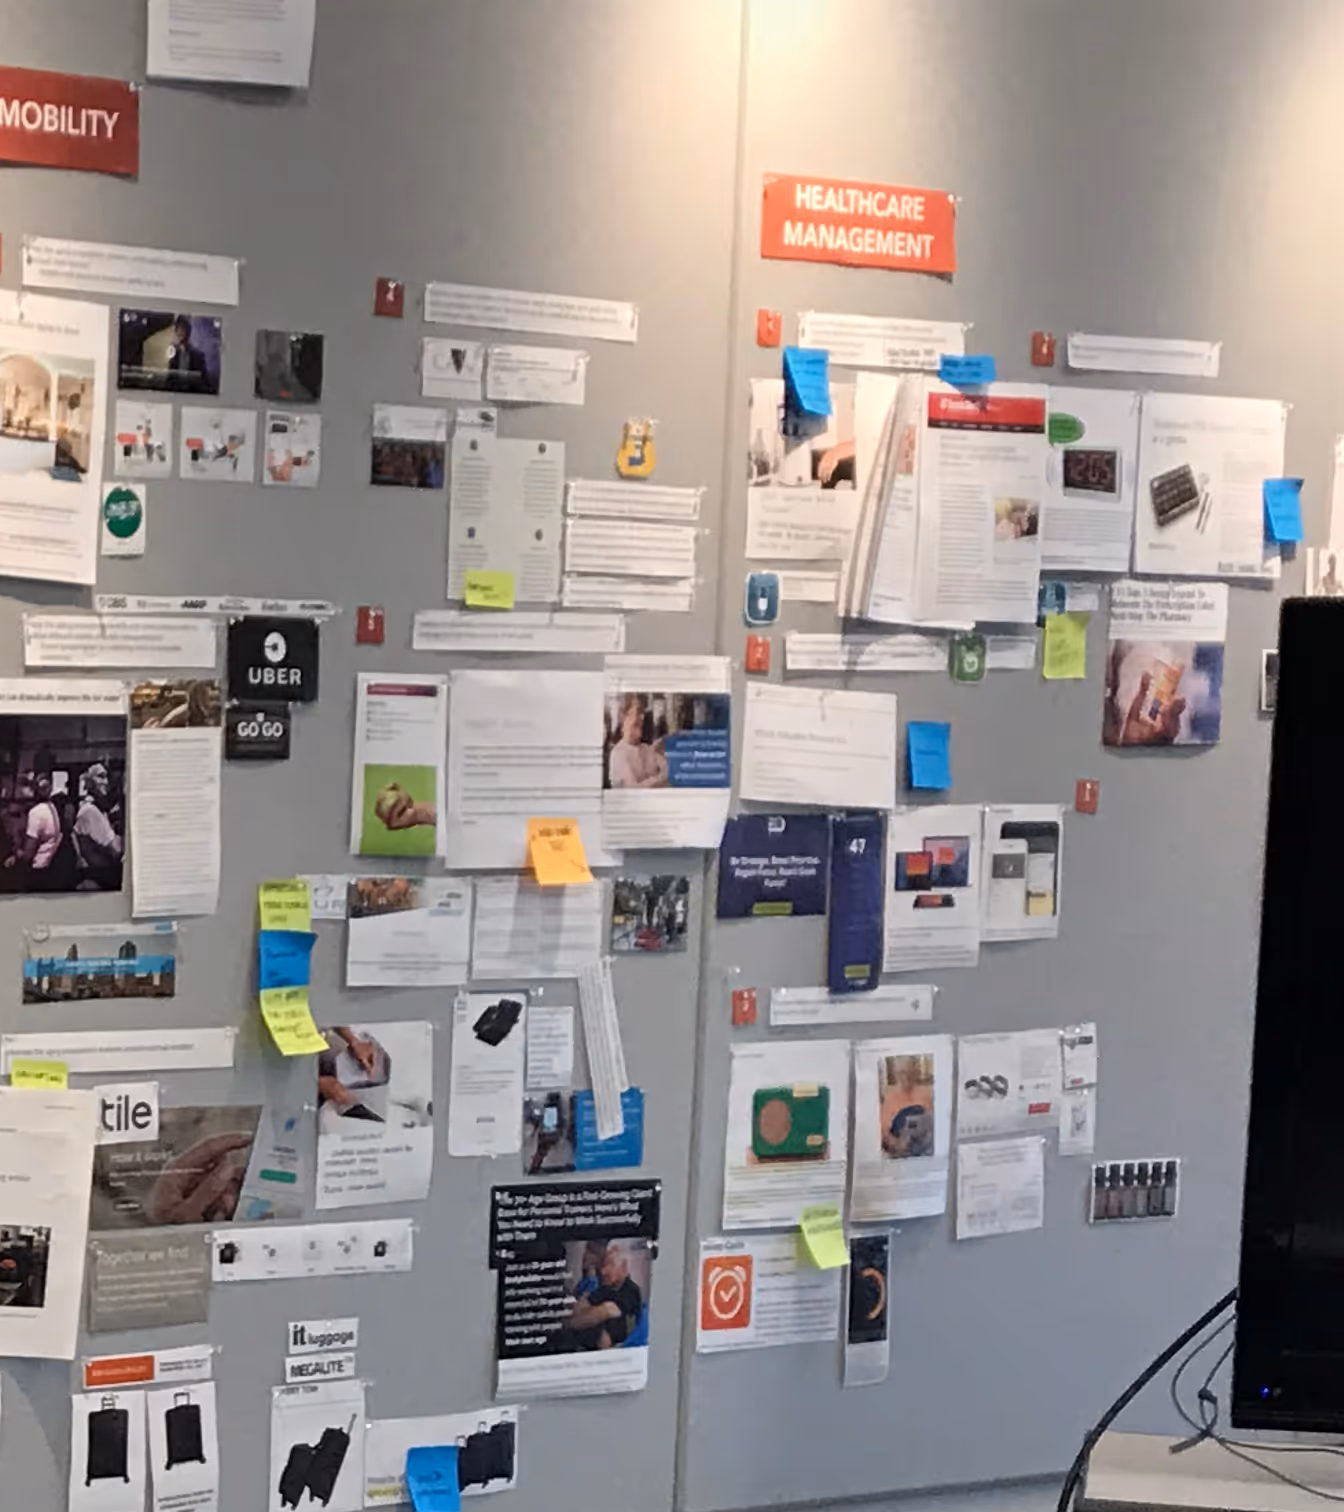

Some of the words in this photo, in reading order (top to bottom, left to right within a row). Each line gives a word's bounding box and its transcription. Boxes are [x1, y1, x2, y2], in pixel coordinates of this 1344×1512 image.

[796, 183, 925, 220] HEALTHCARE
[783, 220, 934, 258] MANAGEMENT
[248, 667, 302, 687] UBER
[849, 838, 867, 854] 47
[100, 1095, 152, 1132] tile
[292, 1325, 306, 1346] it
[290, 1360, 344, 1379] MEGALITE
